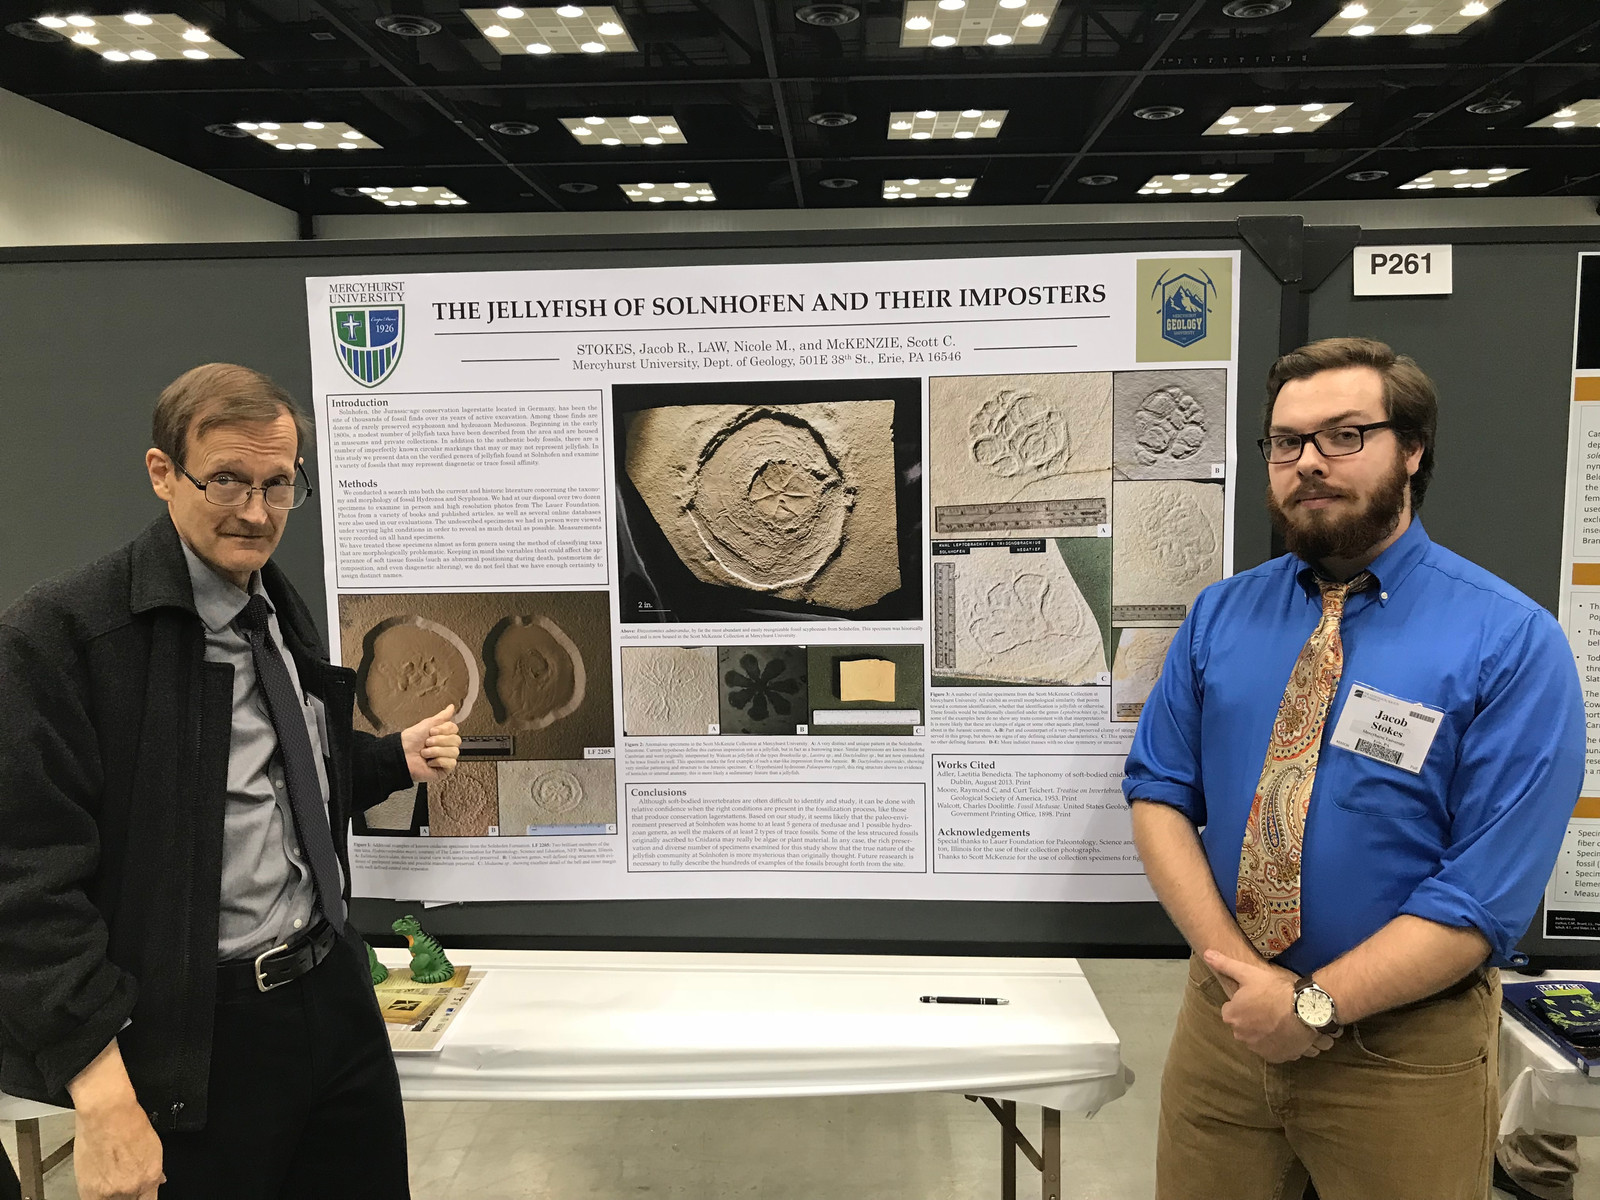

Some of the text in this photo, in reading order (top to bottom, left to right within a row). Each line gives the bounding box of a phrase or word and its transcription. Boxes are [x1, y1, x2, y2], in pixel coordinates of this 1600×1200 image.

[1371, 253, 1430, 274] P261
[330, 282, 404, 292] MERCYHURST
[330, 292, 404, 303] UNIVERSITY
[432, 285, 1105, 323] THE JELLYFISH OF SOLNHOFEN AND THEIR IMPOSTERS
[376, 324, 394, 333] 1926
[1167, 318, 1202, 330] GEOLOGY
[577, 335, 955, 355] STOKES, Jacob R., LAW, Nicole M., and McKENZIE, Scott C.
[572, 360, 636, 371] Mercyhurst
[640, 358, 699, 369] University,
[703, 357, 732, 369] Dept.
[736, 356, 747, 366] of
[750, 356, 795, 368] Geology,
[799, 355, 828, 365] 501E
[855, 354, 873, 364] St.,
[878, 353, 904, 363] Erie,
[908, 352, 924, 362] PA
[928, 351, 961, 362] 16546
[332, 398, 388, 407] Introduction
[339, 479, 377, 487] Methods
[1375, 710, 1408, 727] Jacob
[1371, 722, 1403, 738] Stokes
[970, 761, 995, 769] Cited
[1028, 771, 1063, 779] taphonomy
[975, 779, 996, 787] August
[960, 787, 990, 795] Raymond
[950, 795, 982, 803] Geological
[984, 795, 1006, 803] Society
[990, 810, 1016, 818] Printing
[938, 828, 1030, 838] Acknowledgements
